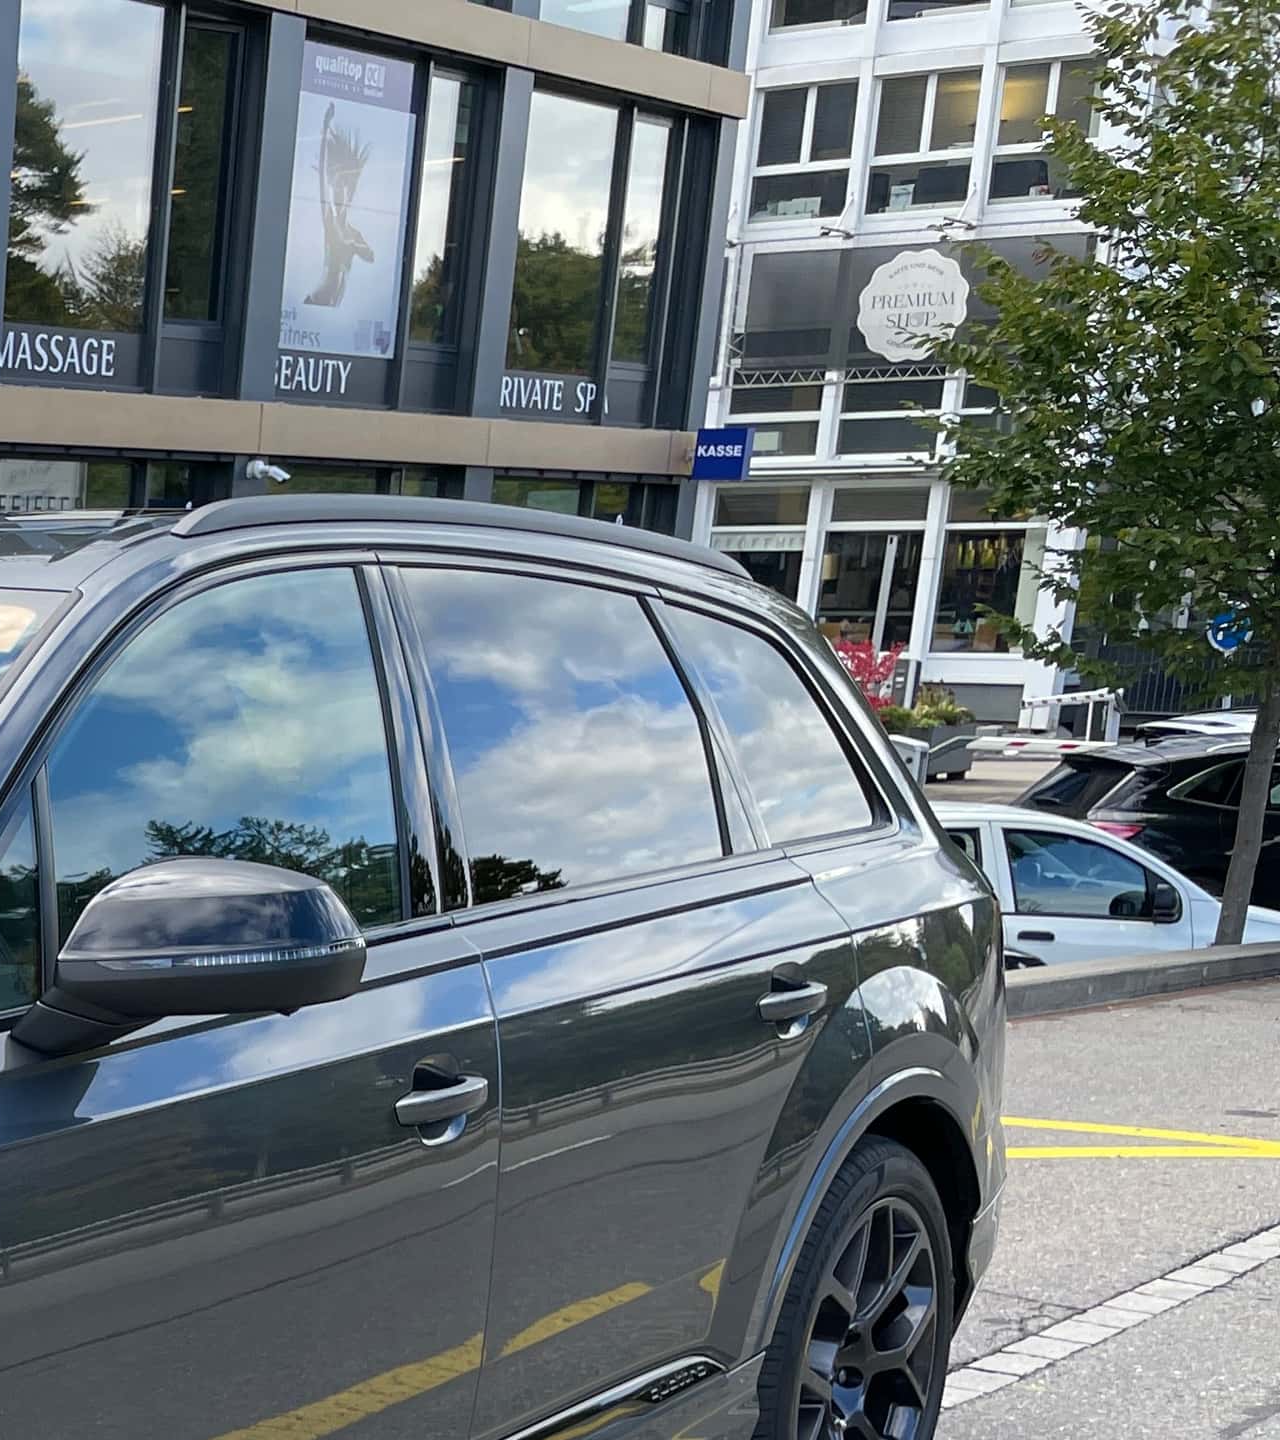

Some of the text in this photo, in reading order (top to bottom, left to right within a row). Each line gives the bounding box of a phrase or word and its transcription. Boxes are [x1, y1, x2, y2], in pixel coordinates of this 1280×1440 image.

[872, 291, 955, 310] PREMIUM
[274, 355, 352, 394] EAUTY
[697, 445, 743, 457] KASSE
